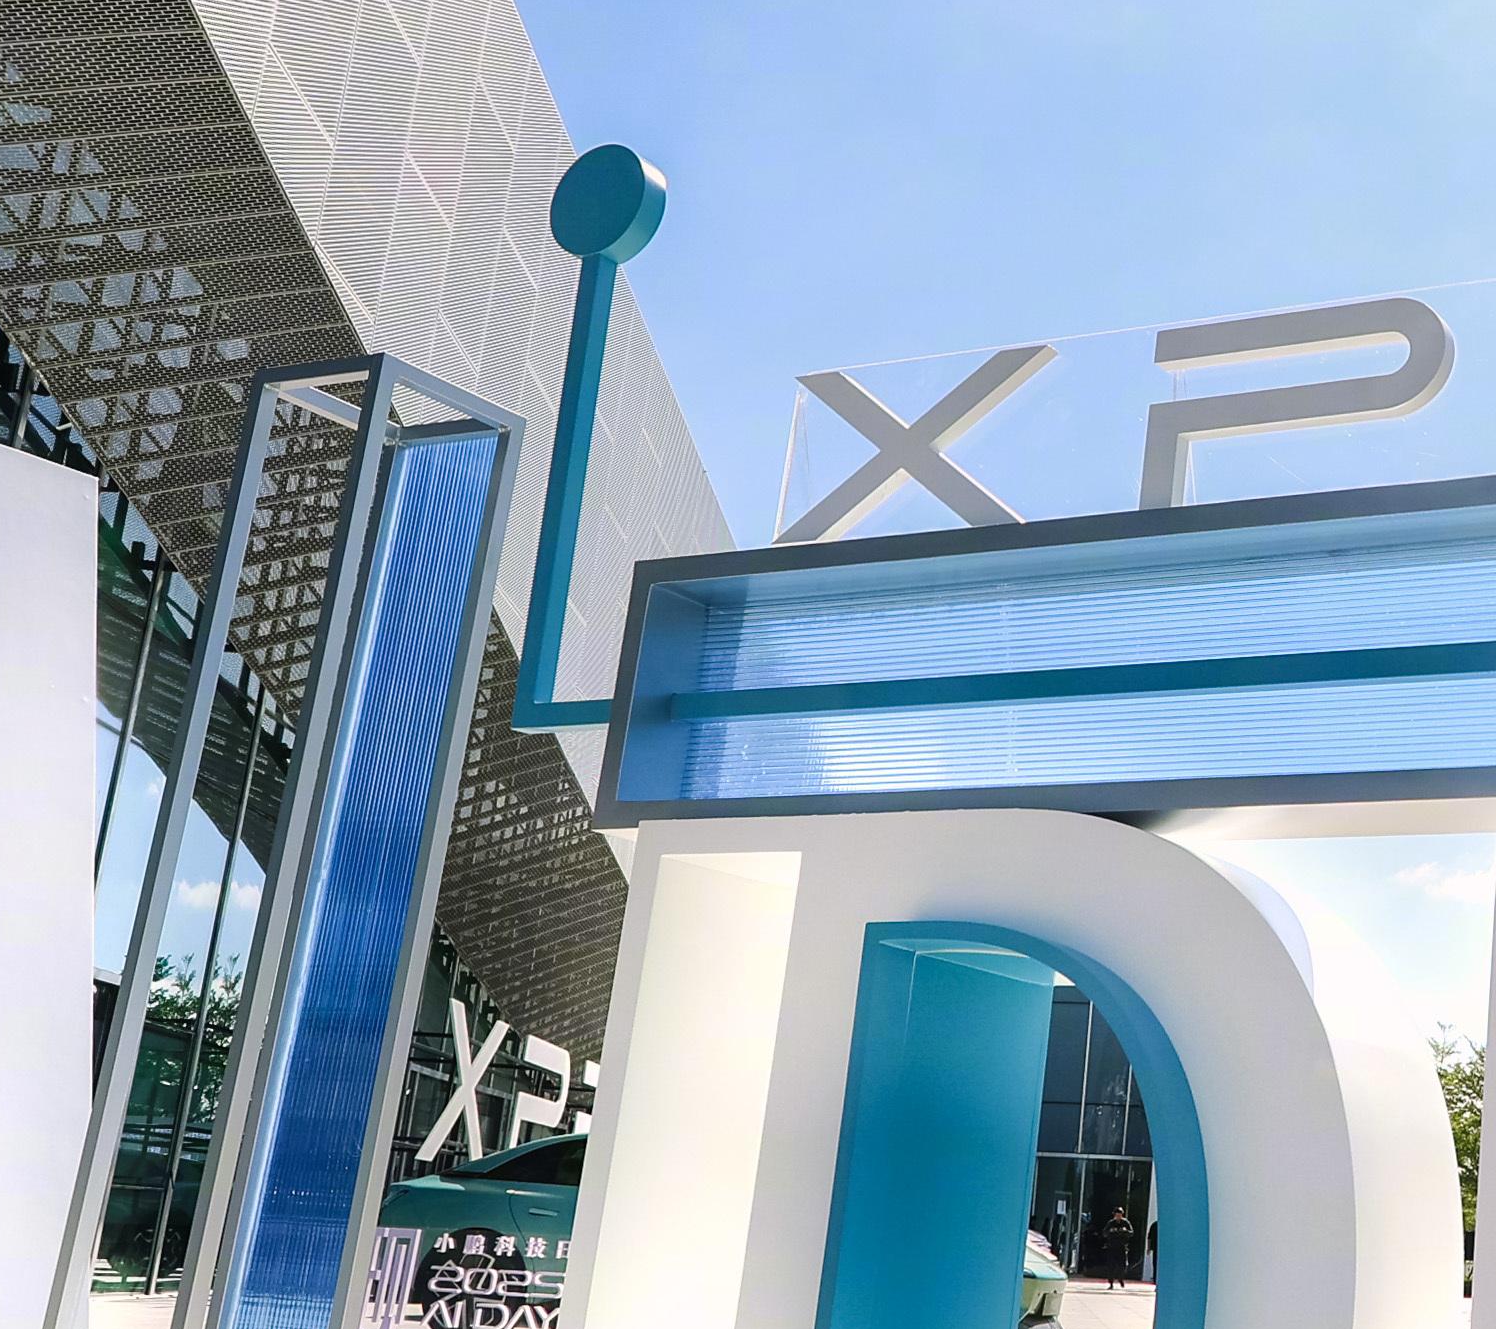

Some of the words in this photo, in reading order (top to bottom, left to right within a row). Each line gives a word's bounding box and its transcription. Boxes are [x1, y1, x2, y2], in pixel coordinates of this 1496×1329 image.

[414, 997, 601, 1163] XP
[426, 1264, 567, 1300] 2025
[420, 1300, 467, 1329] AI
